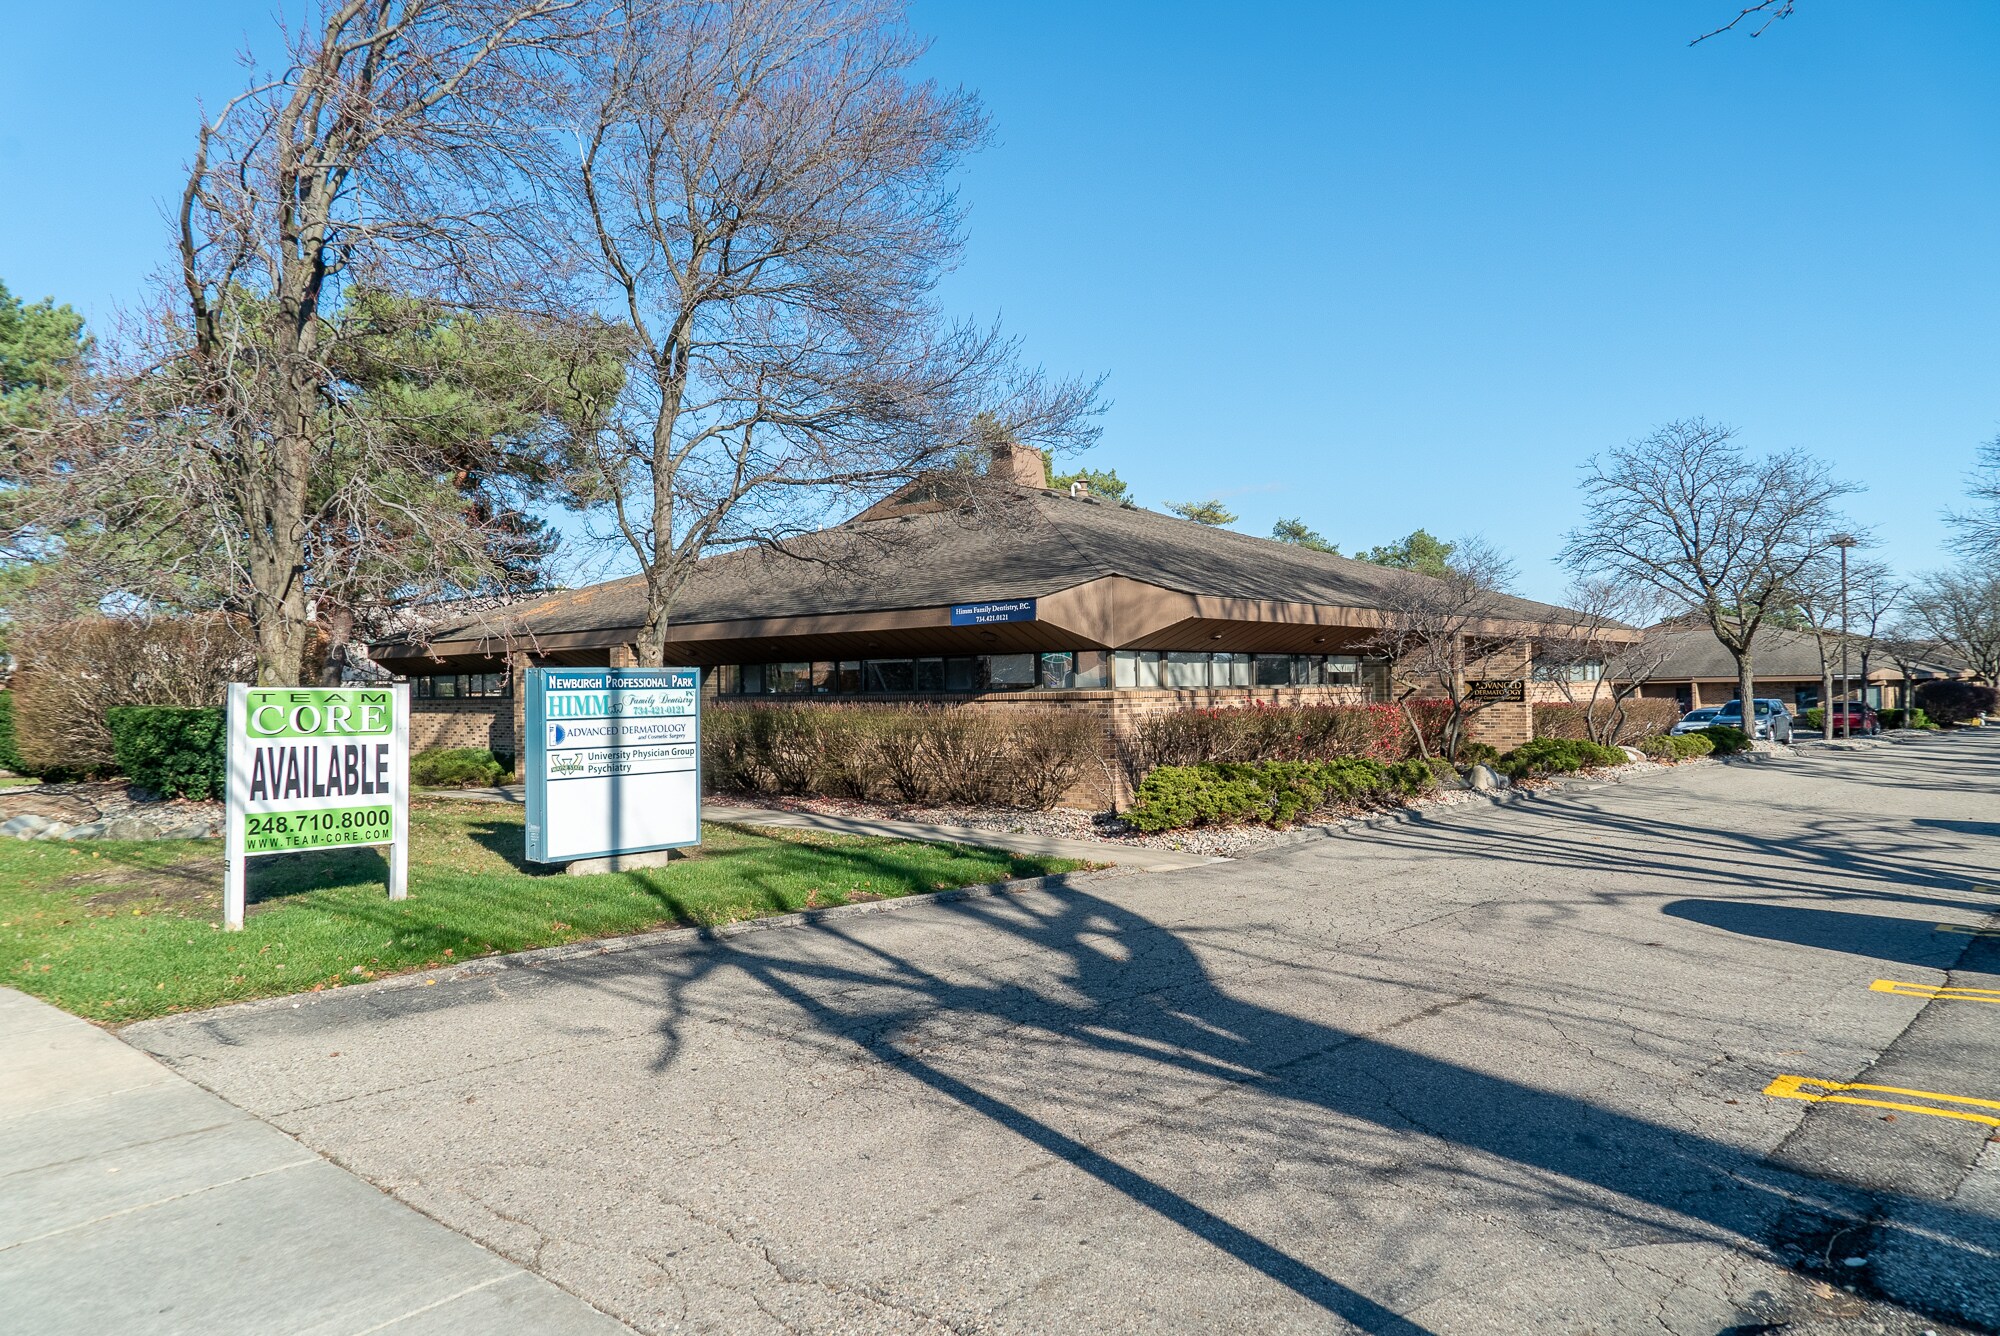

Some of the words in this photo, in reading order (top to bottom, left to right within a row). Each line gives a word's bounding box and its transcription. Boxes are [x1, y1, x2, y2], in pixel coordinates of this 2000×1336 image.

[973, 606, 991, 614] Family
[992, 604, 1019, 612] Dentistry,
[548, 675, 602, 689] NEWBURGH
[606, 674, 668, 688] PROFESSIONAL
[671, 674, 693, 687] PARK
[253, 693, 386, 703] TEAM
[548, 695, 610, 717] HIMM
[622, 693, 655, 707] Family
[658, 692, 694, 707] Dentistry
[633, 705, 685, 715] 734-421-0121
[251, 704, 388, 735] CORE
[567, 726, 619, 737] ADVANCED
[622, 723, 686, 734] DERMATOLOGY
[588, 751, 631, 761] University
[632, 749, 669, 760] Physician
[671, 747, 695, 758] Group
[250, 744, 389, 801] AVAILABLE
[588, 763, 632, 775] Psychiatry
[248, 809, 390, 836] 248.710.8000
[247, 829, 390, 850] WWW.TEAM-CORE.COM
